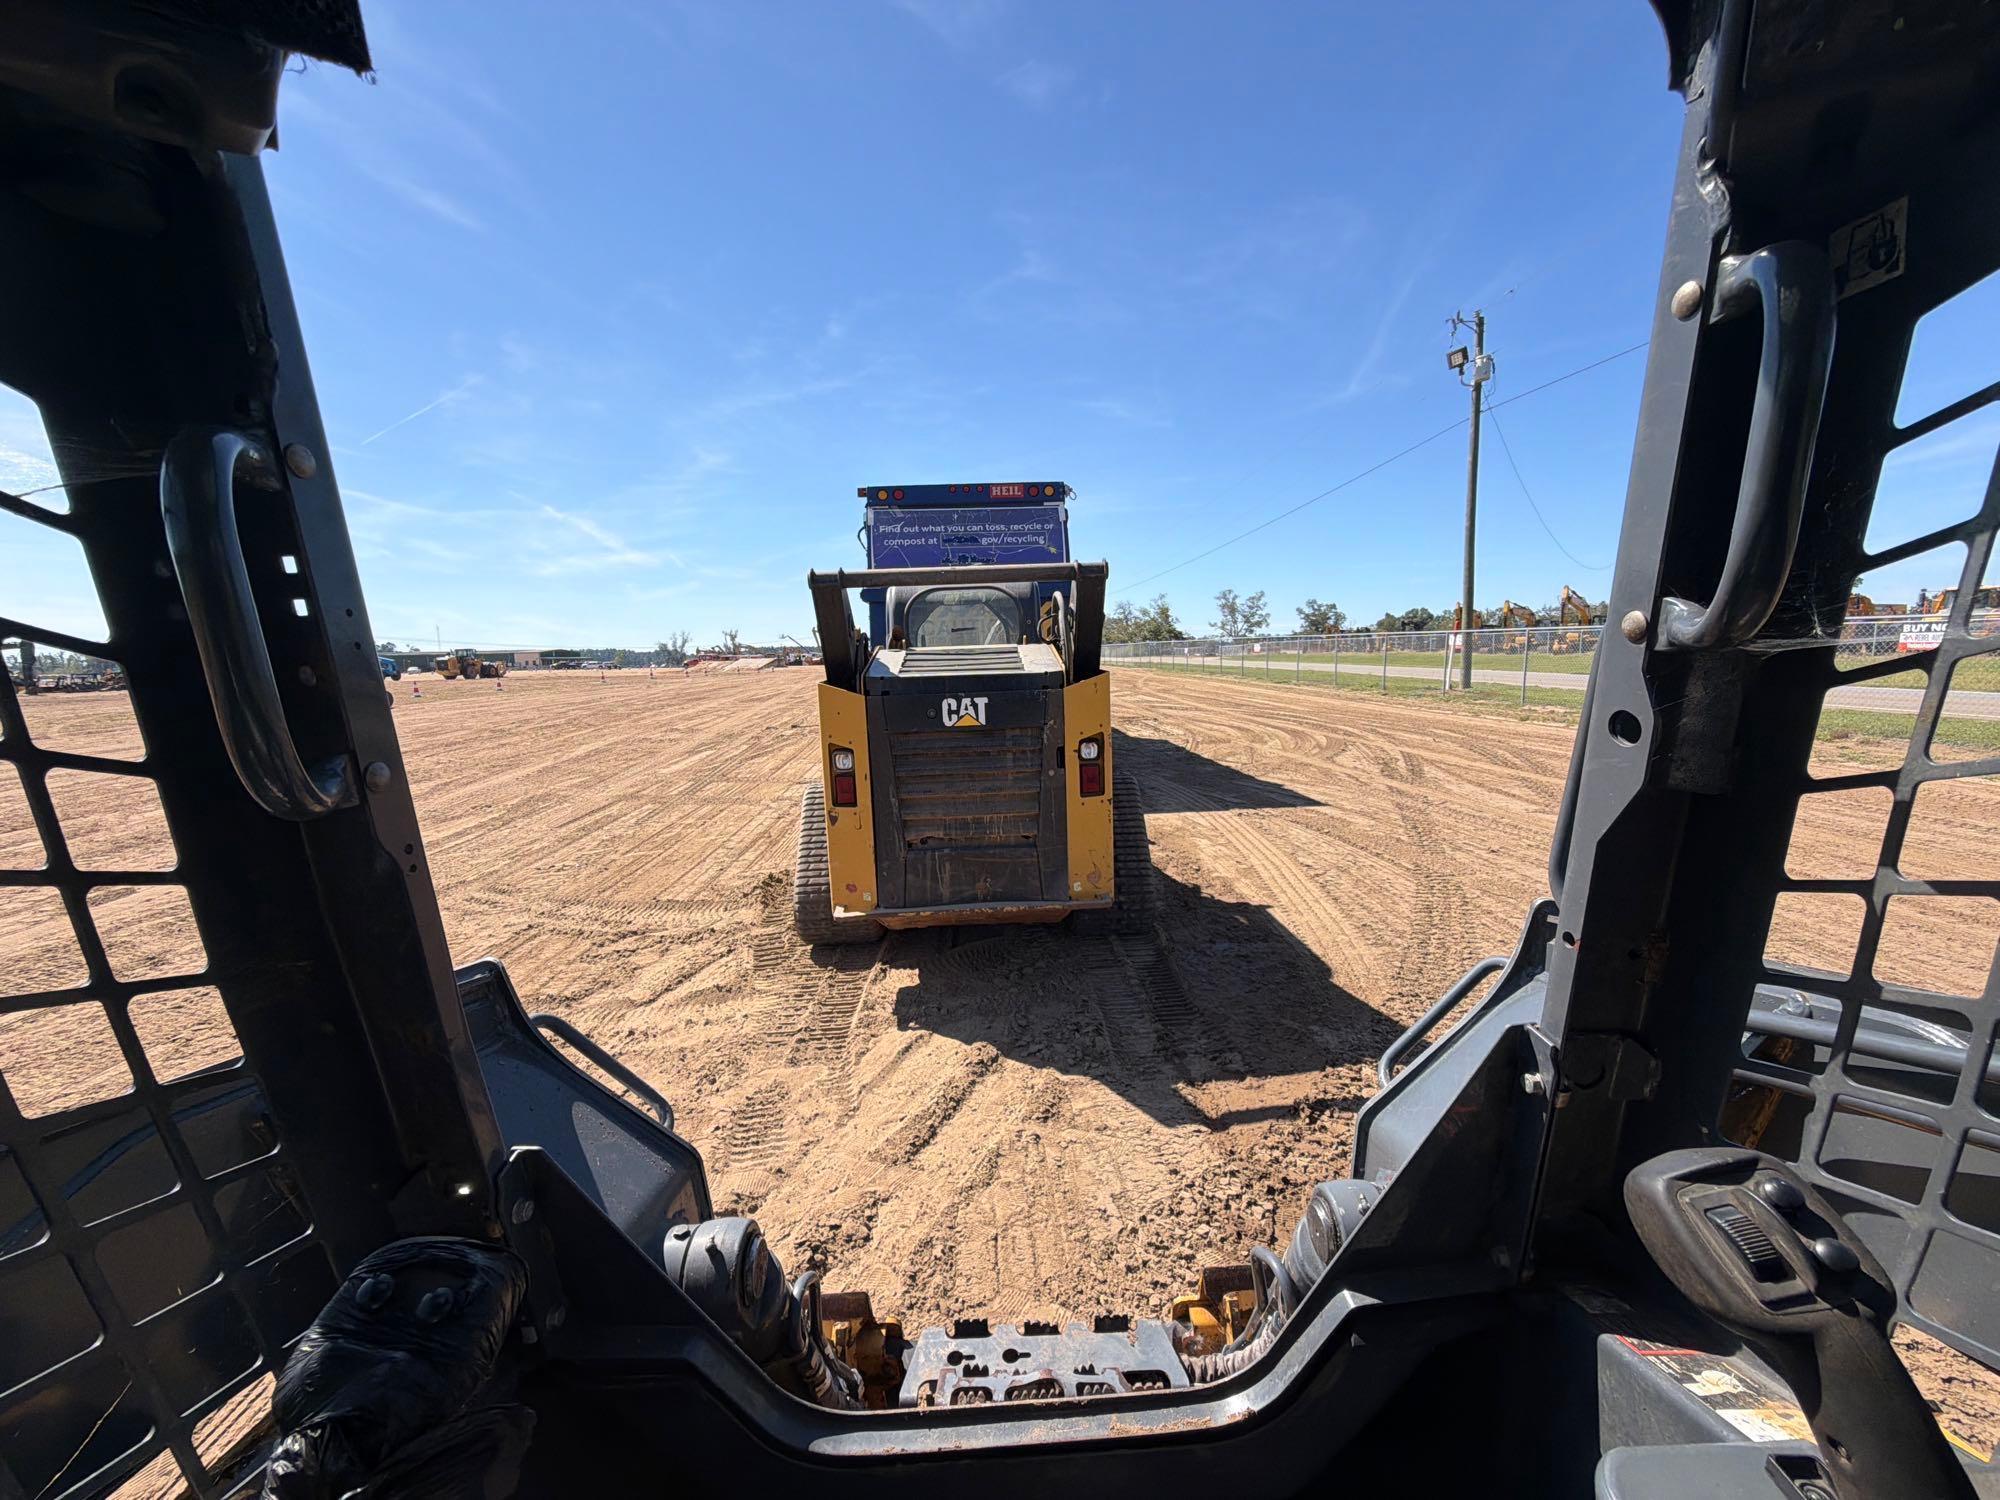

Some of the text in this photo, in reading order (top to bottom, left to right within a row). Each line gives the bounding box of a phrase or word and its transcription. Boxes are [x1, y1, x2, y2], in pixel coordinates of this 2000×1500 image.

[992, 485, 1022, 496] HEIL
[880, 525, 901, 533] Find
[903, 525, 920, 533] out
[921, 524, 945, 532] what
[946, 525, 965, 534] you
[985, 523, 1009, 532] toss,
[1010, 522, 1042, 532] recycle
[1043, 523, 1055, 531] or
[883, 537, 926, 547] compost
[927, 537, 938, 545] at
[1903, 624, 1930, 632] BUY
[941, 696, 989, 727] CAT
